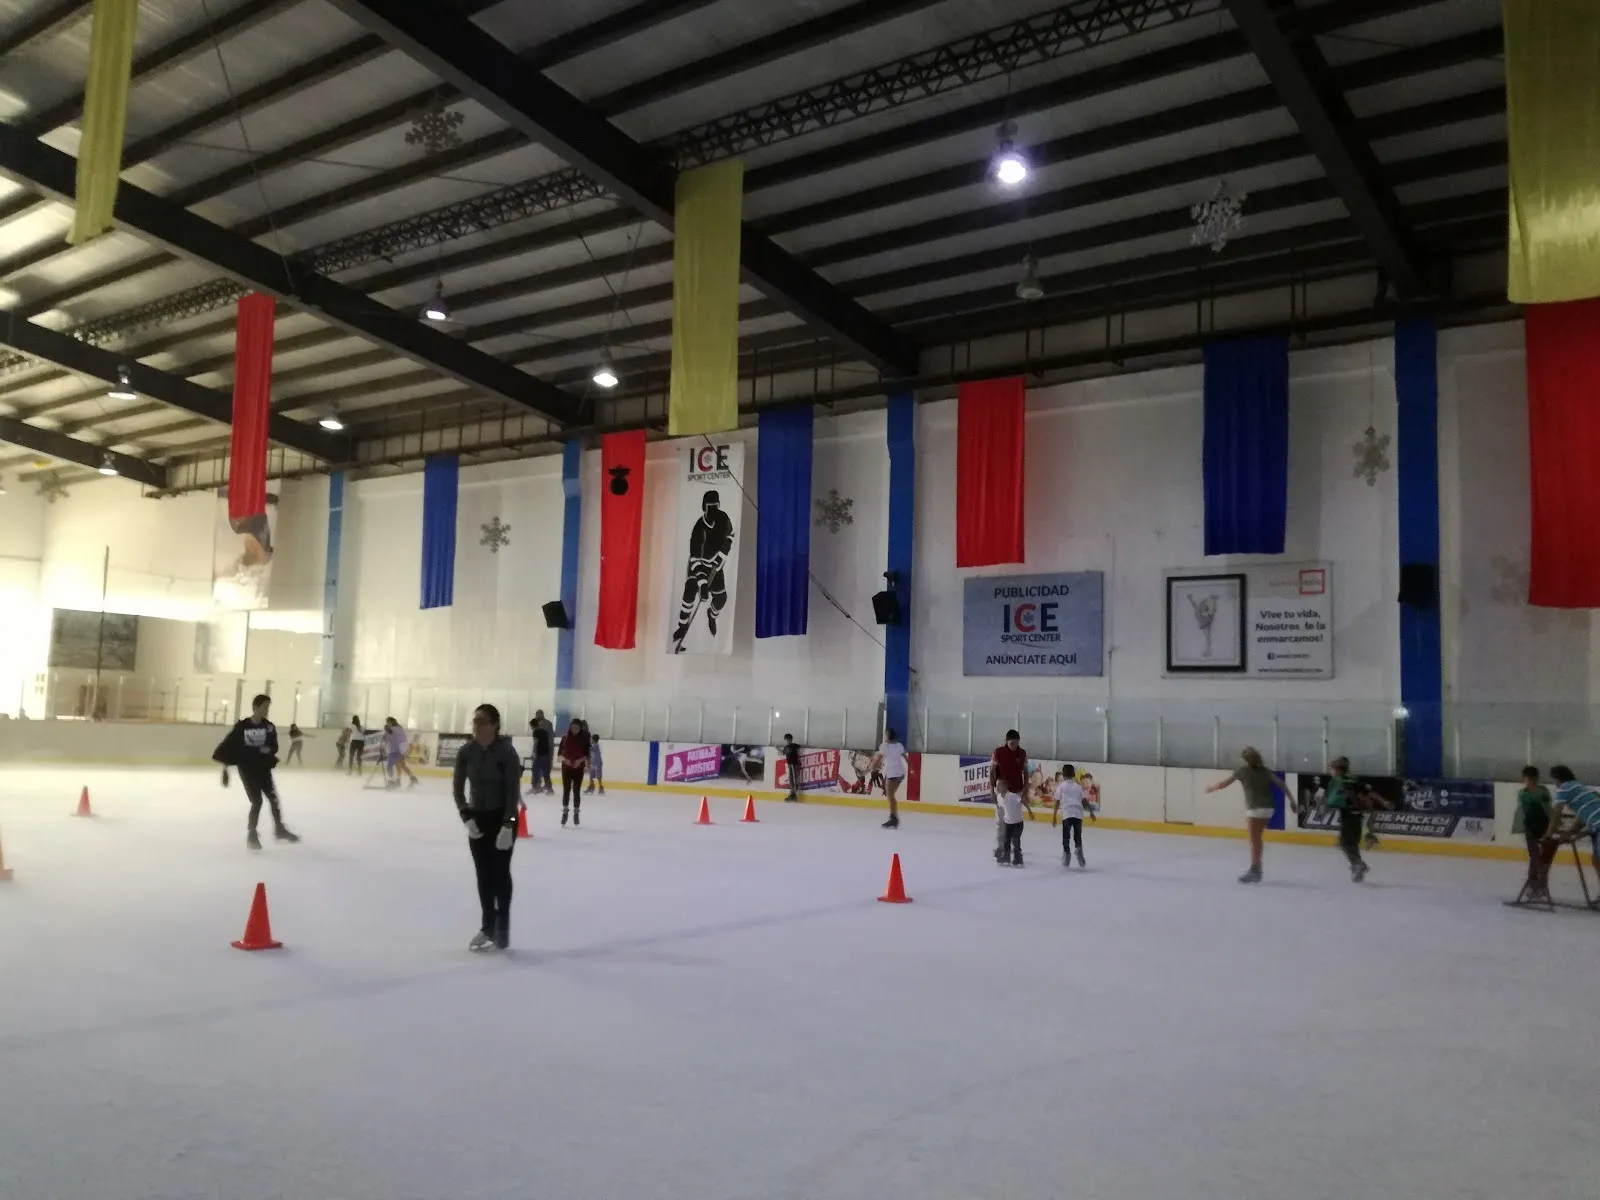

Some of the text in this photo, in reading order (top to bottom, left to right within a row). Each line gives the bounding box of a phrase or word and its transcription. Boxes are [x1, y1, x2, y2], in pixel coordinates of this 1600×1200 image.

[690, 445, 729, 472] ICE
[688, 472, 730, 481] SPORT CENTER
[994, 585, 1069, 598] PUBLICIDAD
[1003, 602, 1058, 633] ICE
[1260, 610, 1282, 619] Vive
[1255, 623, 1300, 631] Nosotros
[1001, 633, 1061, 643] SPORT CENTER
[1257, 634, 1324, 643] enmarcamos!
[1049, 653, 1077, 665] AQUÍ
[798, 750, 835, 767] SCUELA DE
[964, 765, 991, 781] TU FIE
[963, 782, 991, 794] CUMPLEA
[1375, 813, 1450, 825] DE HOCKEY
